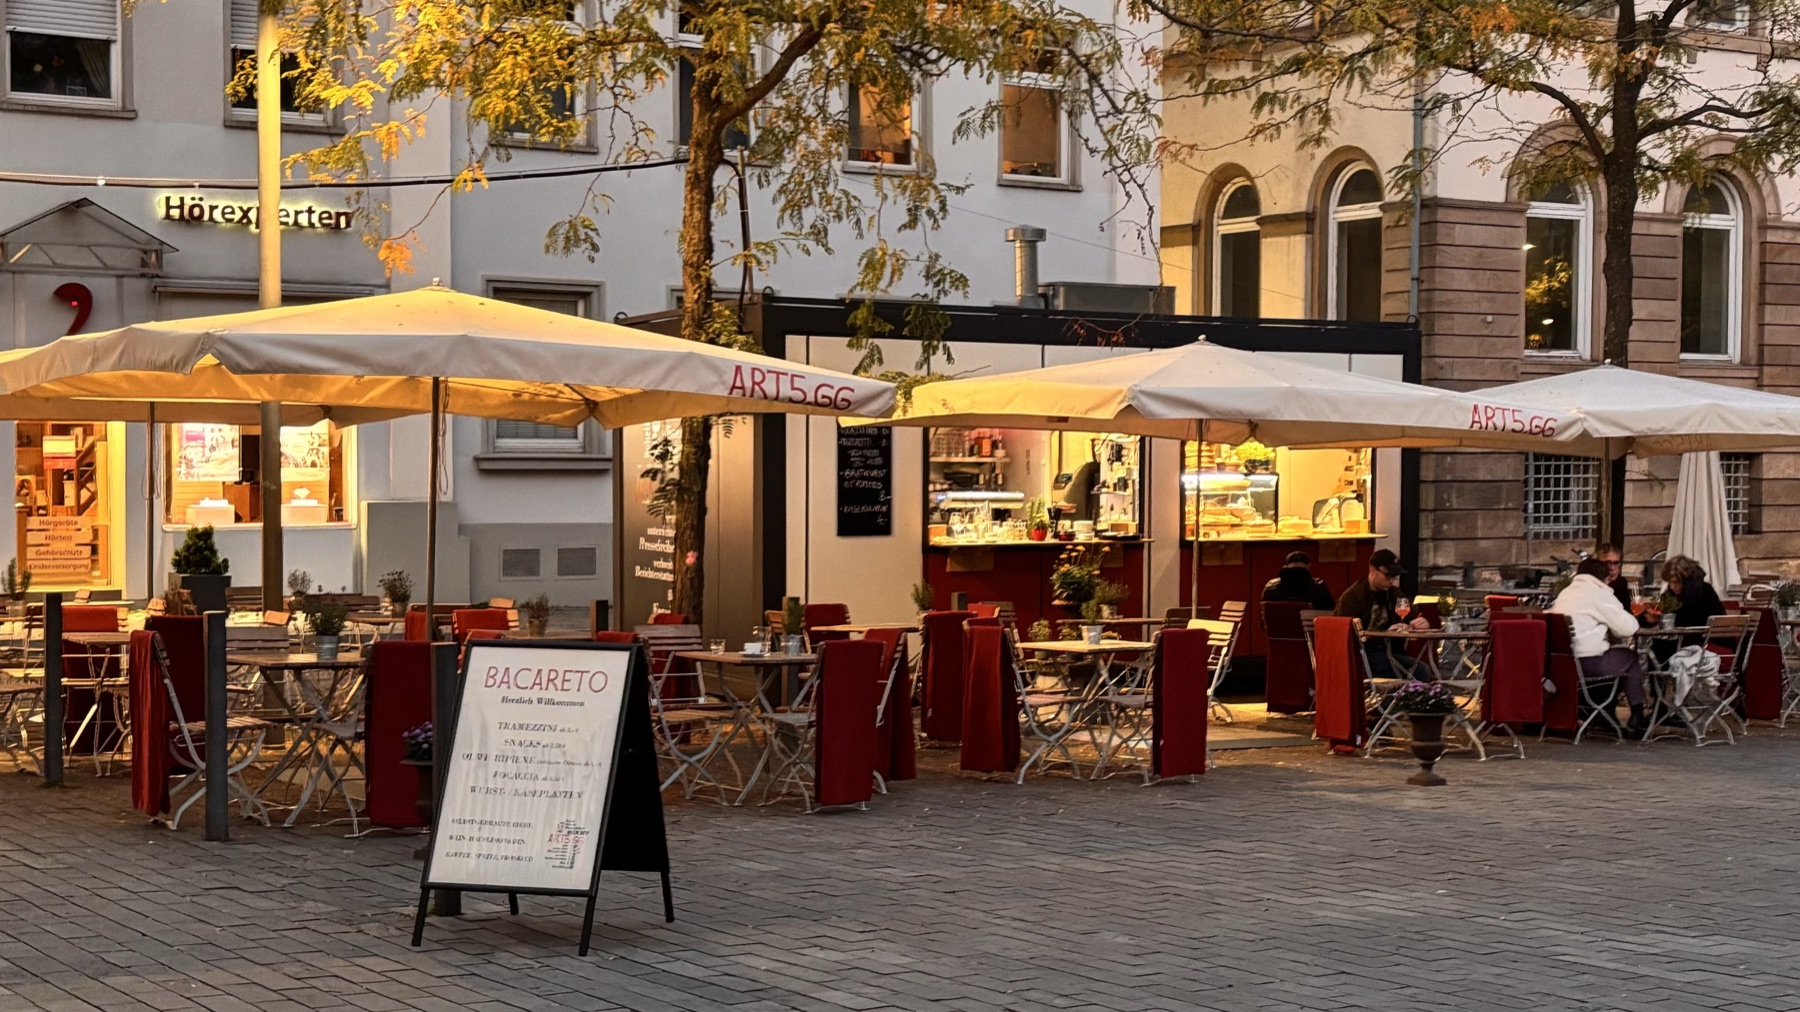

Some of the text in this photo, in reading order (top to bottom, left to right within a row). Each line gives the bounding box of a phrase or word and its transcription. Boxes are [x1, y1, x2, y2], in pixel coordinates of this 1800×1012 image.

[163, 196, 352, 230] Hörexerten
[728, 365, 855, 411] ART5.GG
[1469, 404, 1558, 438] ART5.GG
[484, 666, 608, 693] BACARETO
[501, 695, 585, 707] Herzlich Willkommen
[504, 739, 541, 748] SNACKS
